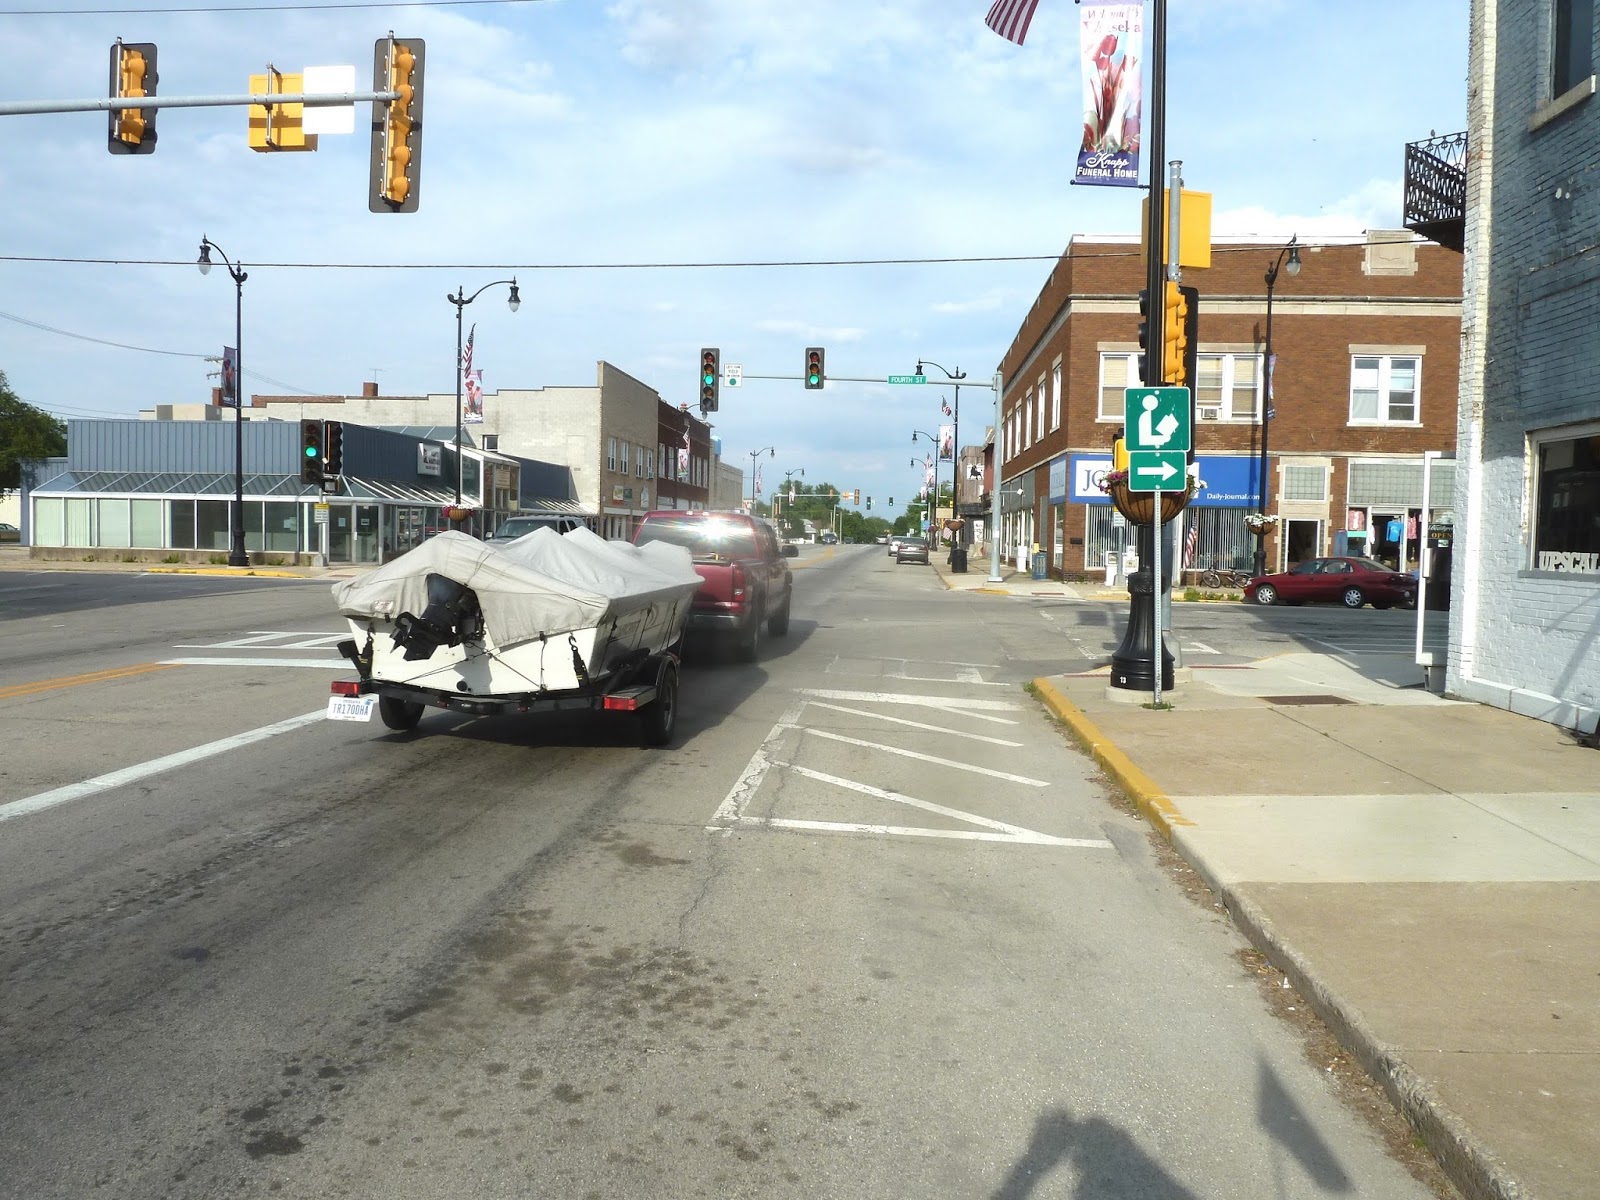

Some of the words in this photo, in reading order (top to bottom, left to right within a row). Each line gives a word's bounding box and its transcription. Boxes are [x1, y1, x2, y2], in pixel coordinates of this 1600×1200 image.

[1085, 151, 1130, 169] Knapp
[1077, 166, 1112, 177] FUNERAL
[1114, 168, 1138, 178] HOME
[1539, 551, 1600, 575] UPSCAL
